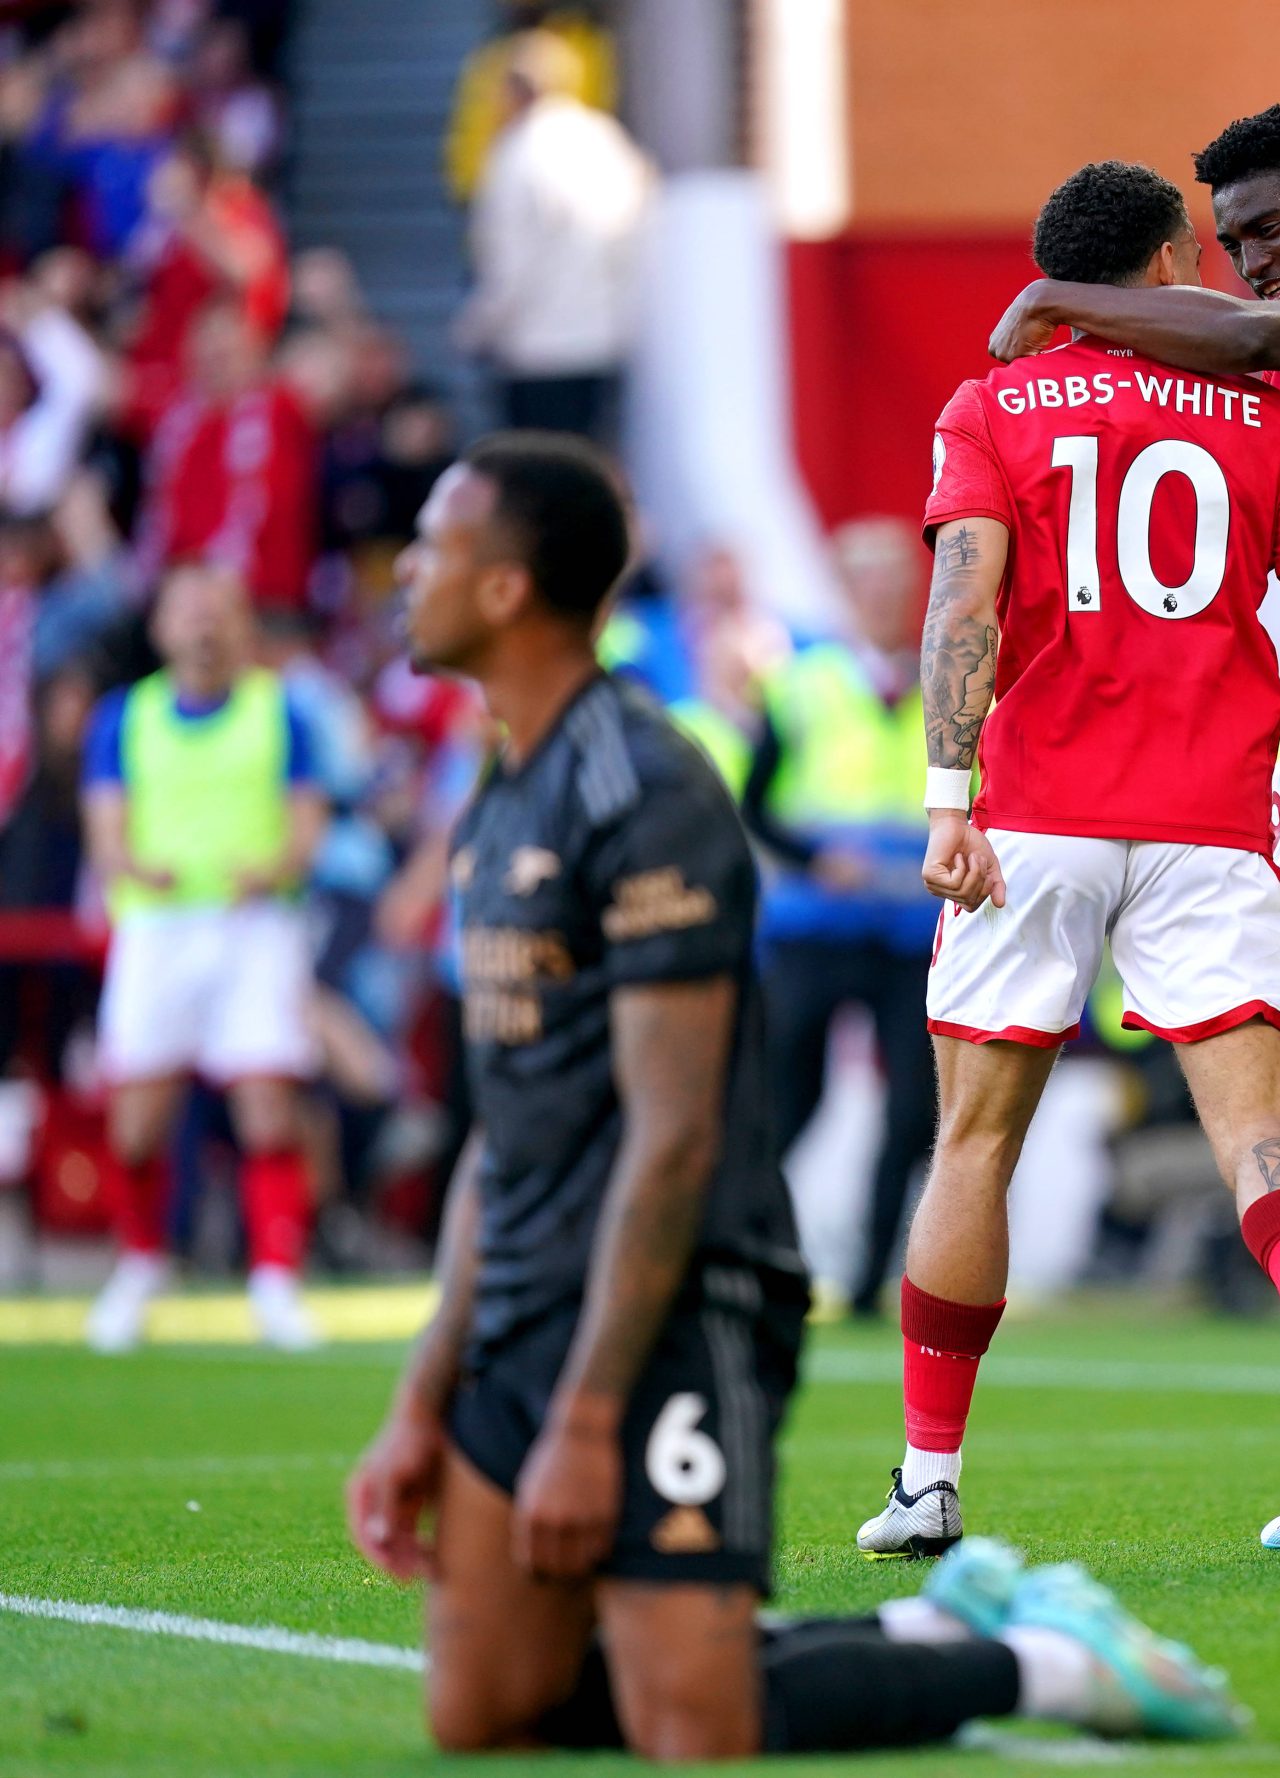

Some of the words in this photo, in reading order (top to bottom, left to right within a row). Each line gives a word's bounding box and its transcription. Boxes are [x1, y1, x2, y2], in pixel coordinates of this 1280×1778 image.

[997, 371, 1261, 428] GIBBS-WHITE
[1051, 435, 1231, 620] 10
[645, 1391, 727, 1506] 6
